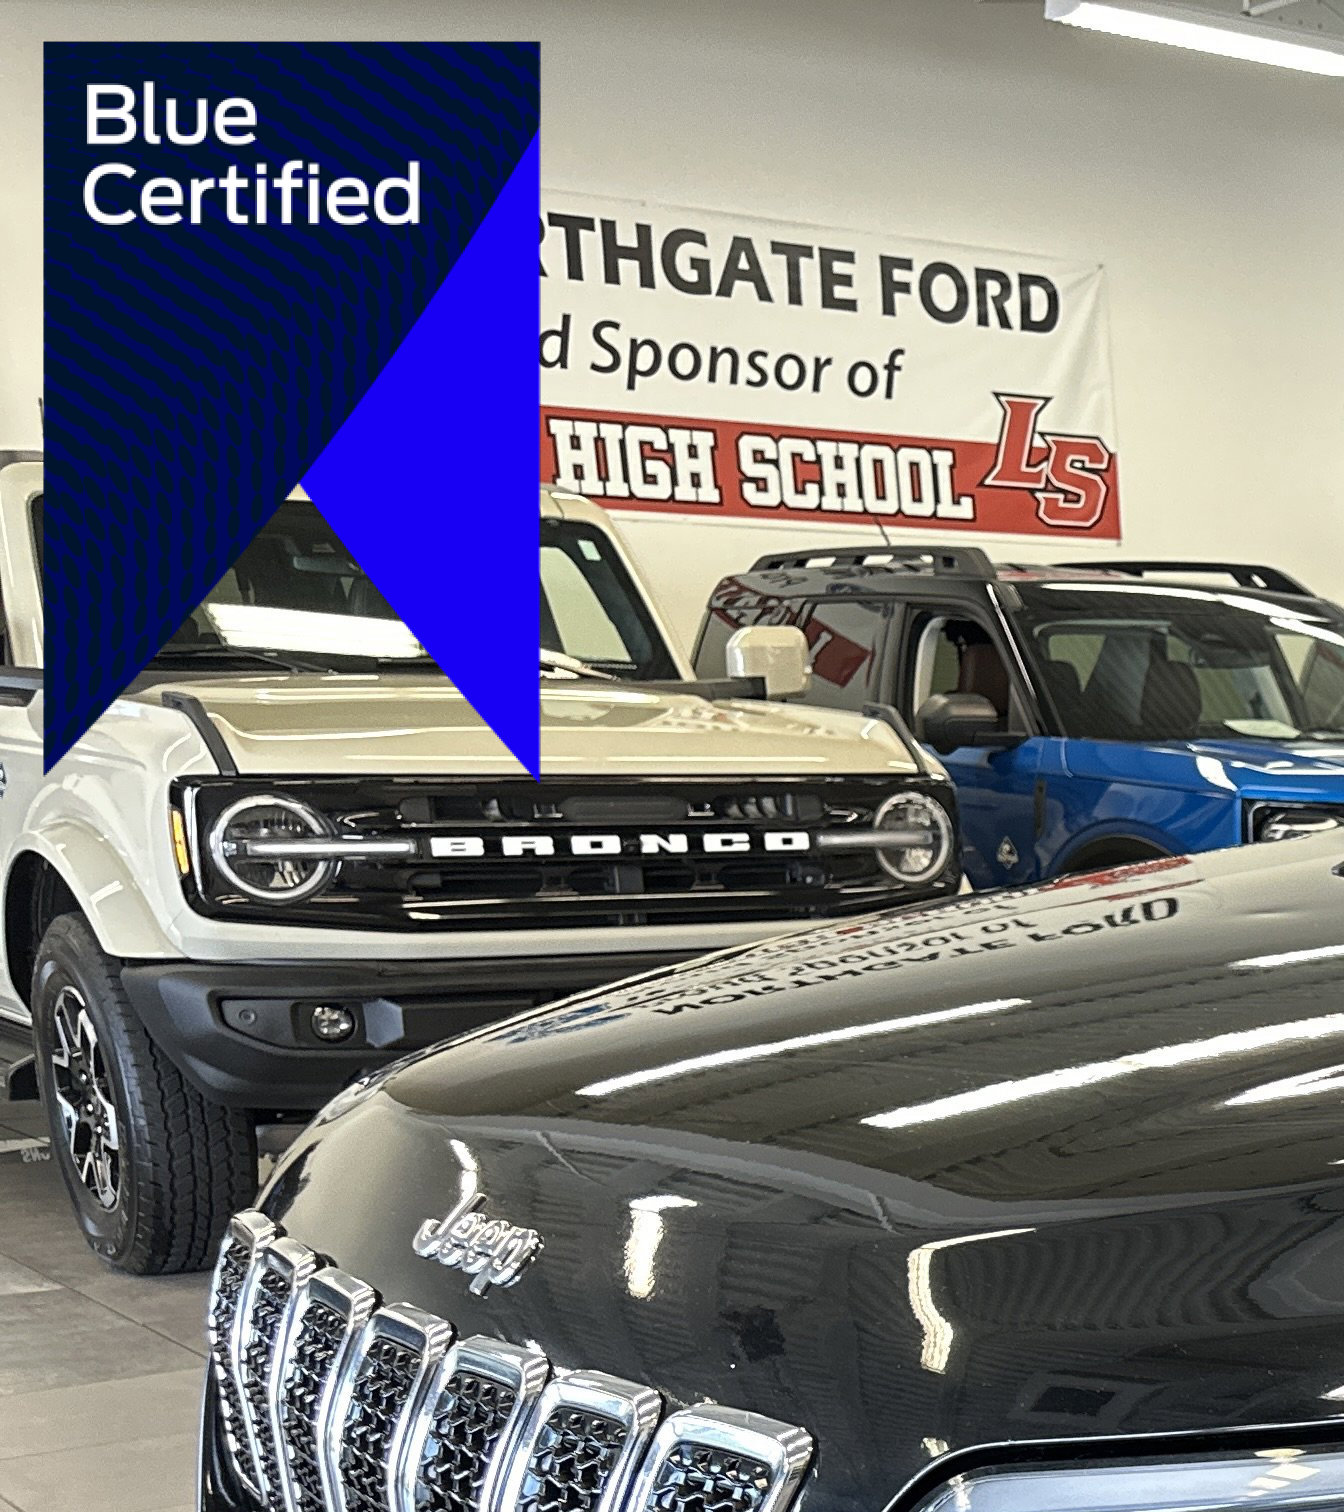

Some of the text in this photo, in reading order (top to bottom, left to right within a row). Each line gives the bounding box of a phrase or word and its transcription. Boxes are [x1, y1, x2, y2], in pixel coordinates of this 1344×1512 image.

[540, 211, 1061, 333] THGATE FORD
[589, 318, 833, 391] Sponsor
[847, 348, 905, 399] of
[548, 416, 976, 522] HIGH SCHOOL
[430, 831, 811, 859] BRONCO
[412, 1193, 543, 1299] Jeep
